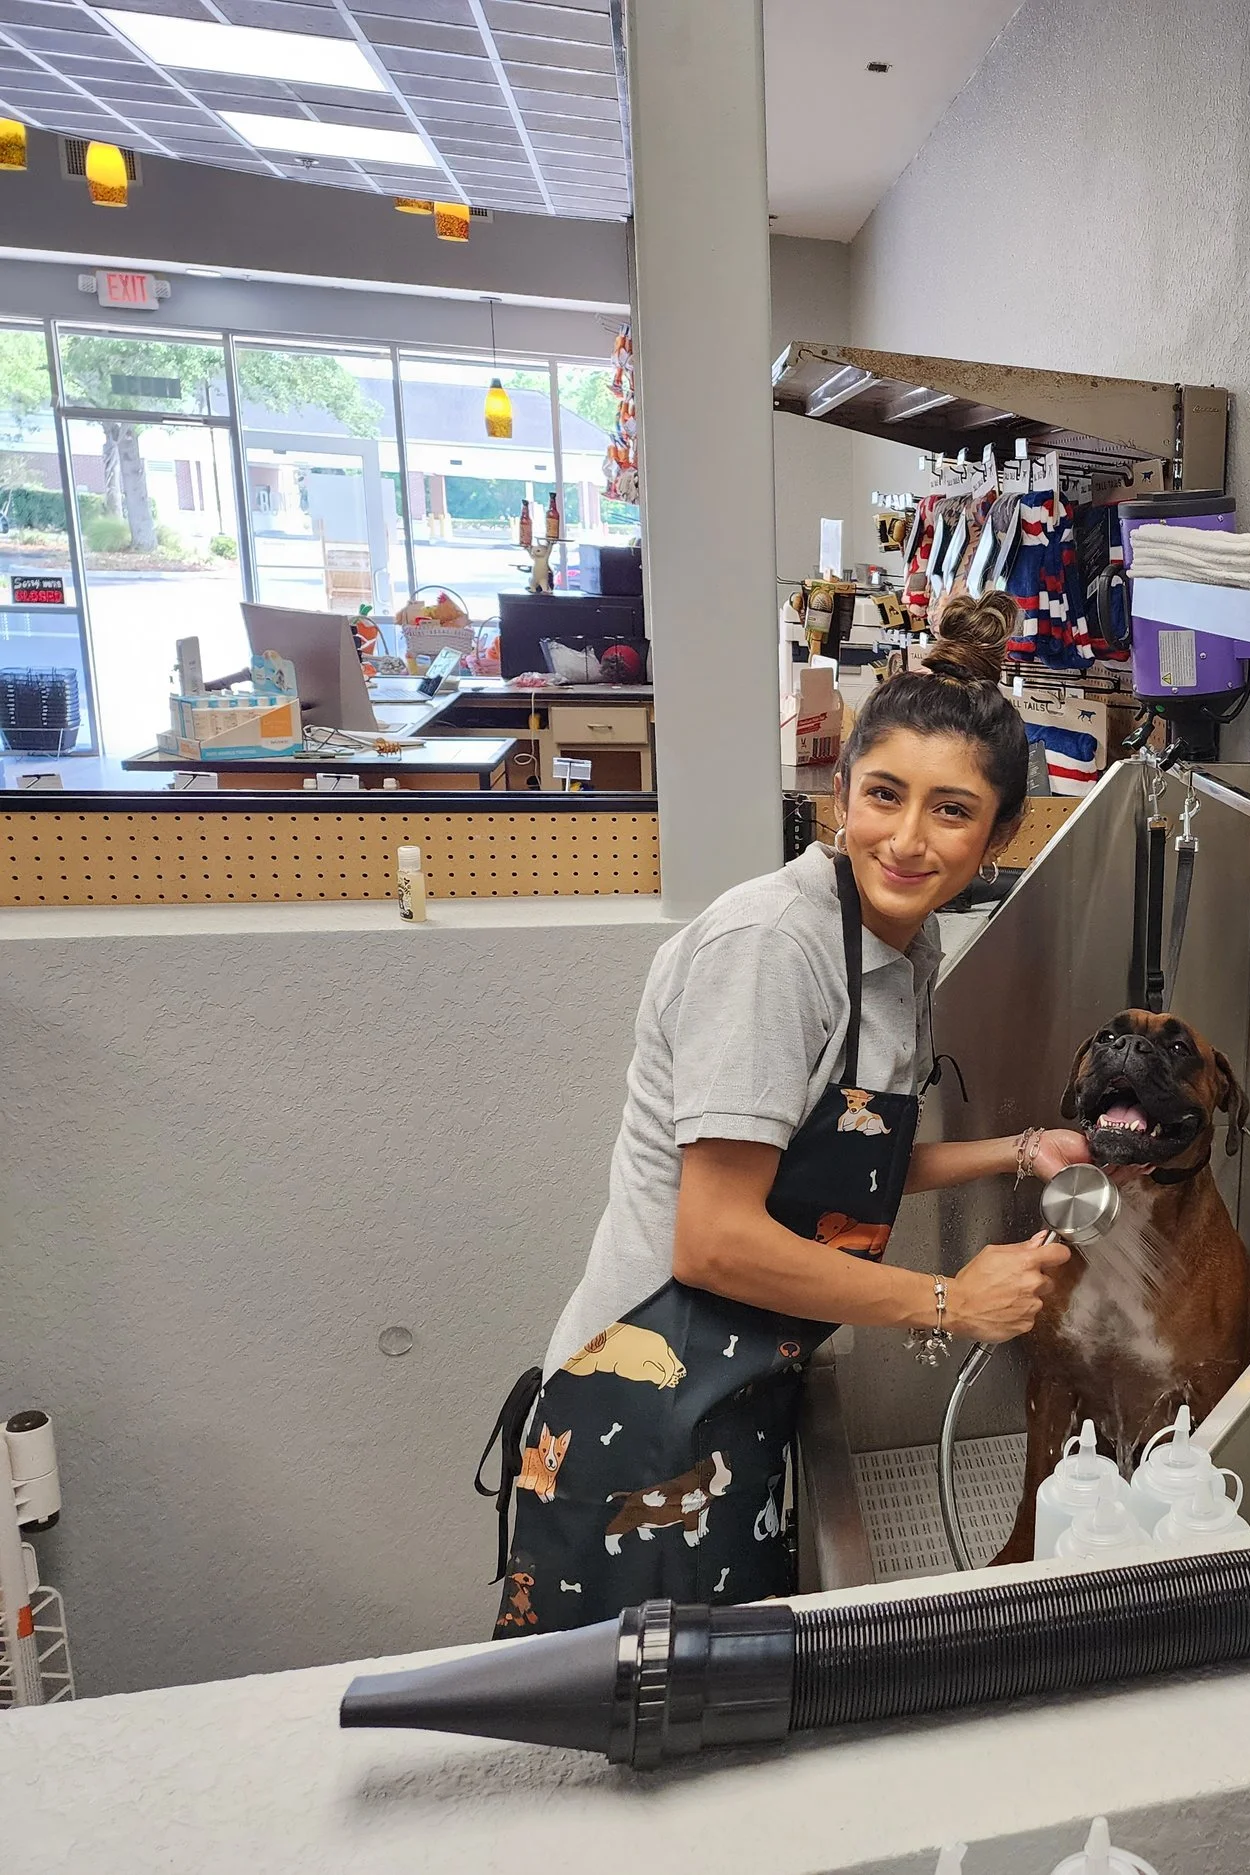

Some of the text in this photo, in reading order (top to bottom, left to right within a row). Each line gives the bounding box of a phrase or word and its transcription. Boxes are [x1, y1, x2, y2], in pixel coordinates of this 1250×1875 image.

[106, 273, 147, 303] EXIT
[14, 577, 40, 589] Sorry
[14, 589, 62, 603] CLOSED
[1024, 701, 1046, 712] TAILS
